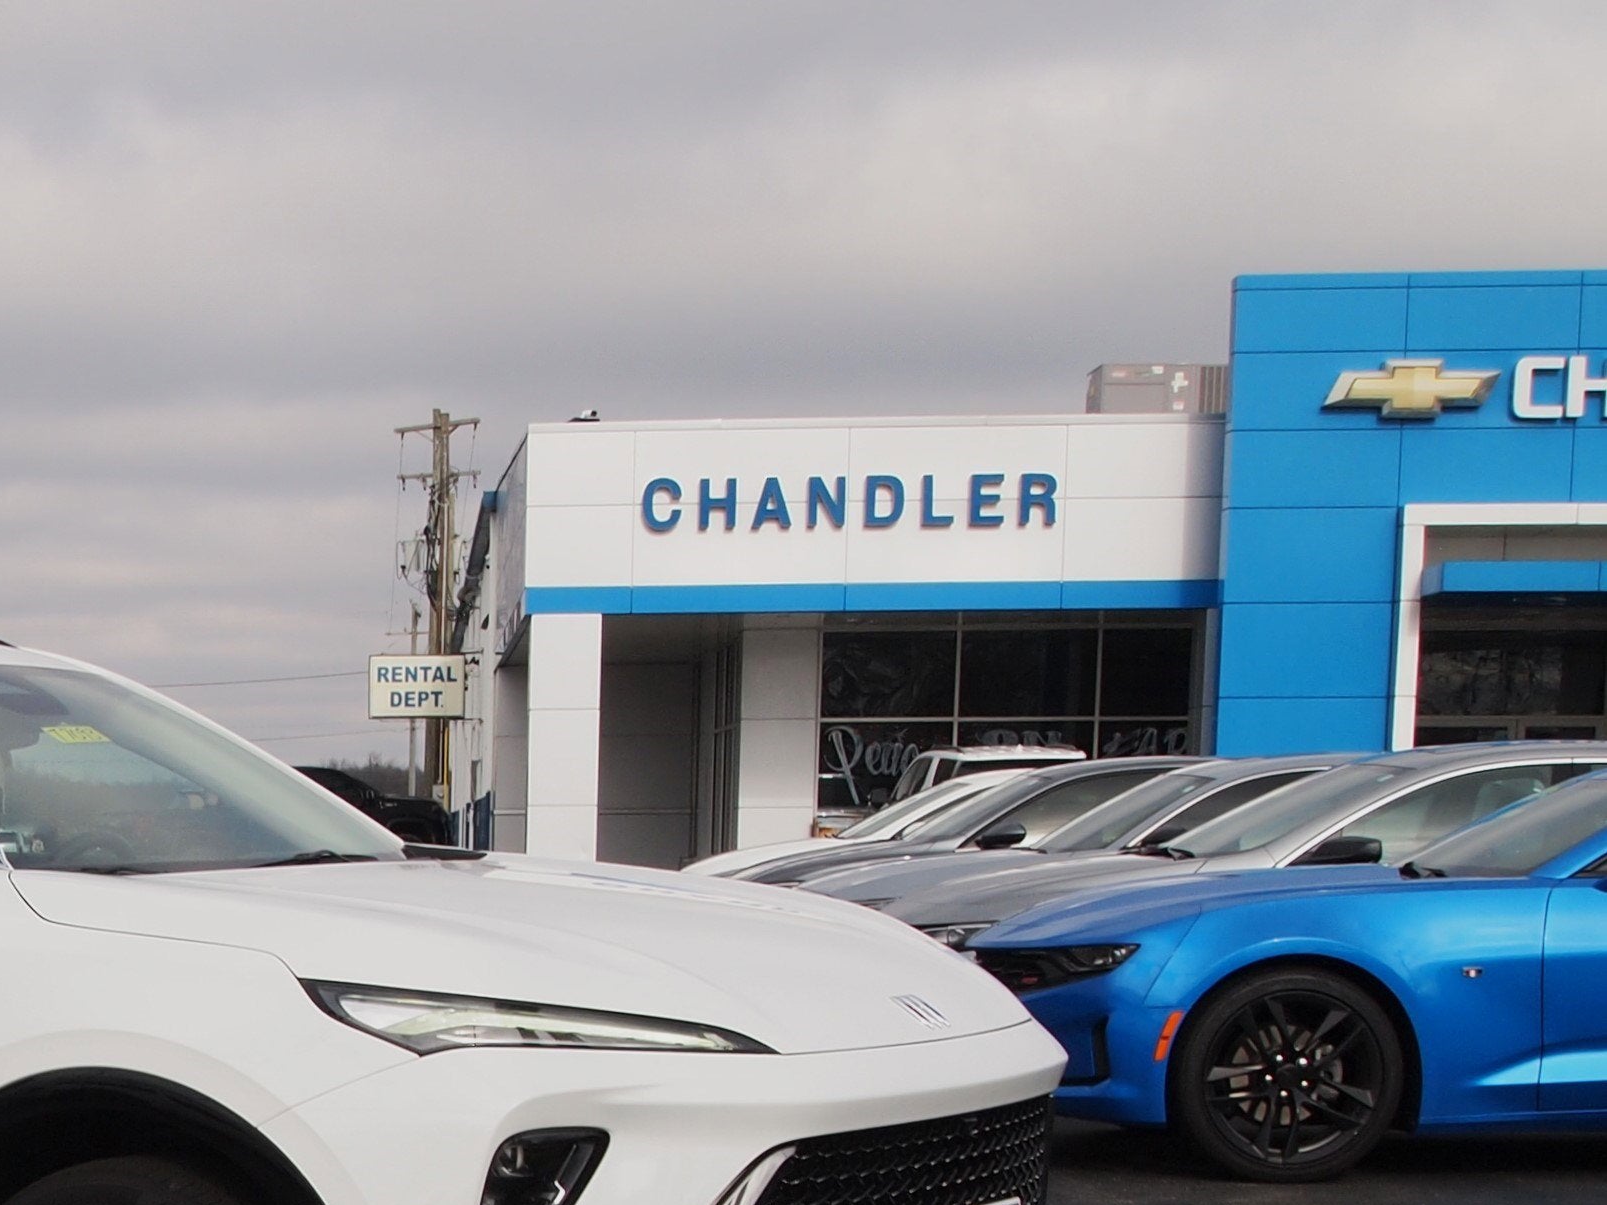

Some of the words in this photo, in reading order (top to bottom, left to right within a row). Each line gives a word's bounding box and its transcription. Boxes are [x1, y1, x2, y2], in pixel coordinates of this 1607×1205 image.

[641, 472, 1058, 532] CHANDLER
[377, 666, 458, 682] RENTAL
[390, 691, 444, 708] DEPT.
